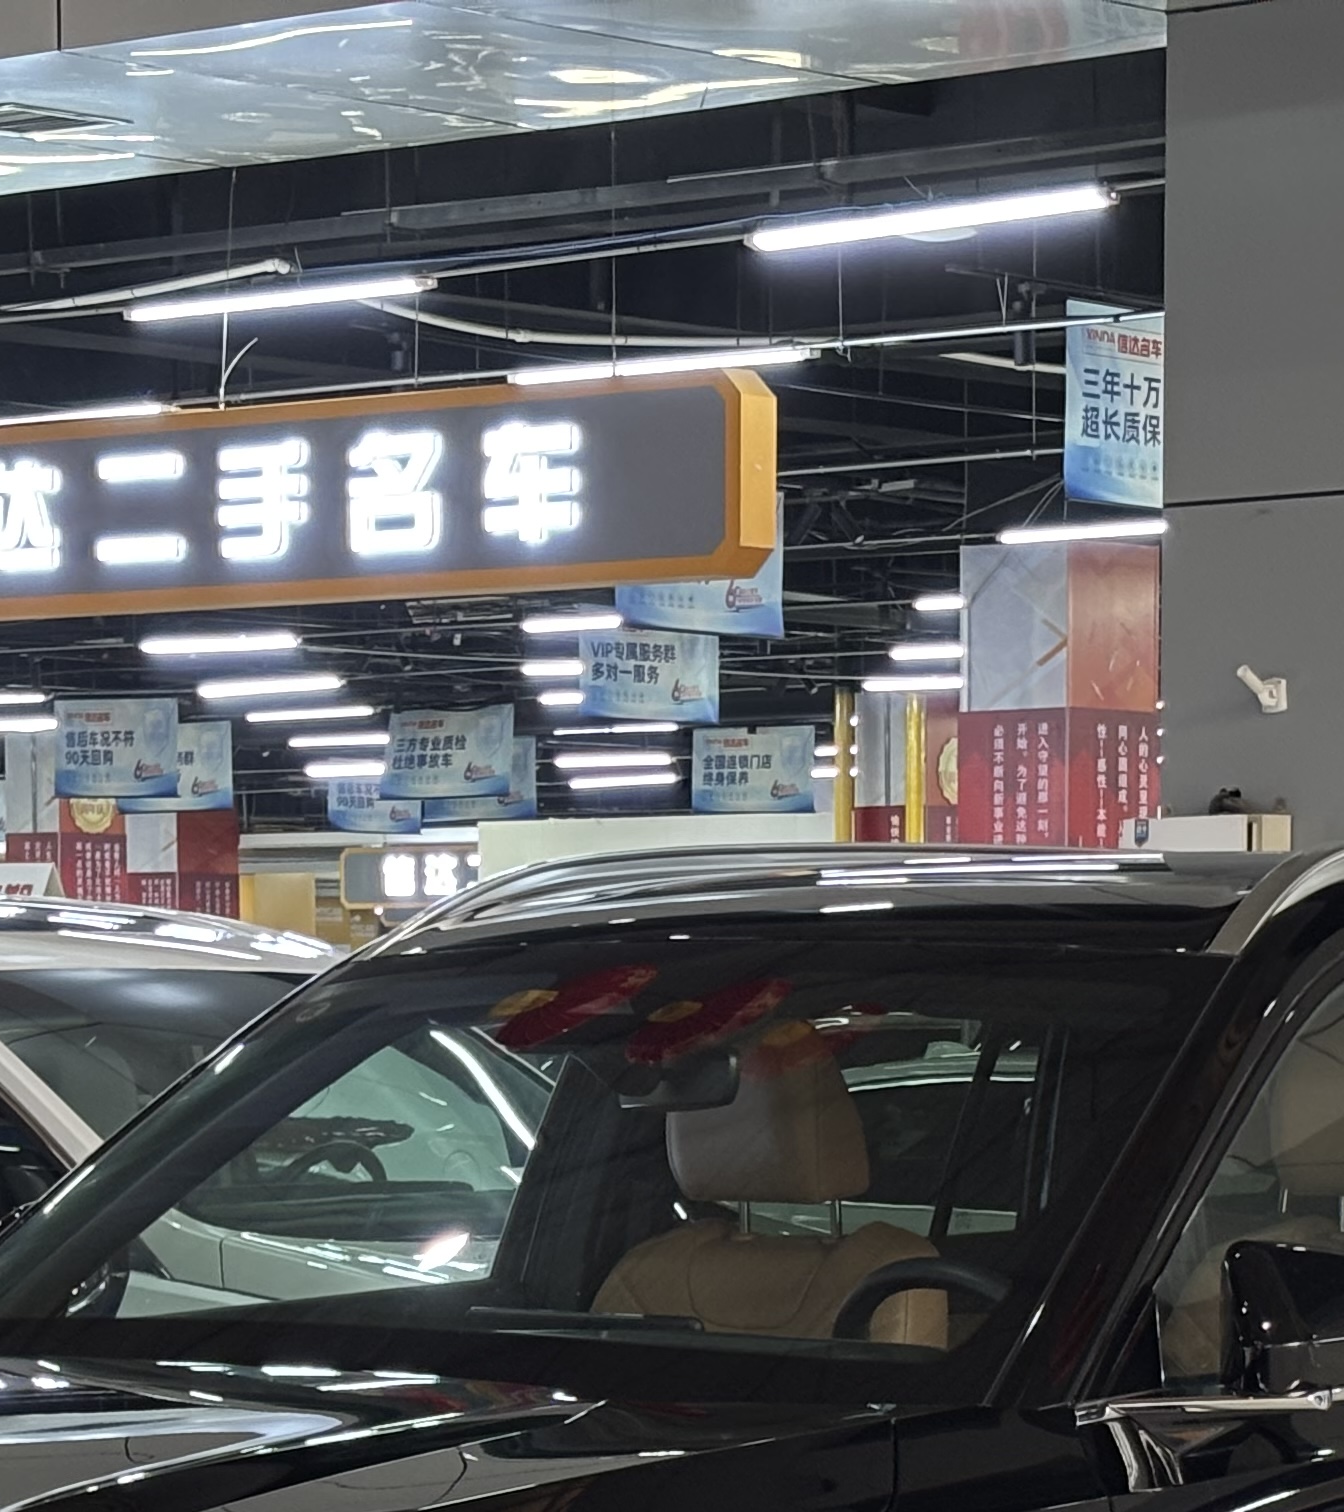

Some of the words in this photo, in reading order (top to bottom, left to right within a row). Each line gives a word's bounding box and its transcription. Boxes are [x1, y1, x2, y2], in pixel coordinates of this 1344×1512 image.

[1082, 367, 1161, 408] 三年十万
[1081, 404, 1161, 447] 超长质保
[591, 641, 676, 663] VIP专属服务群
[592, 663, 659, 685] 多对一服务
